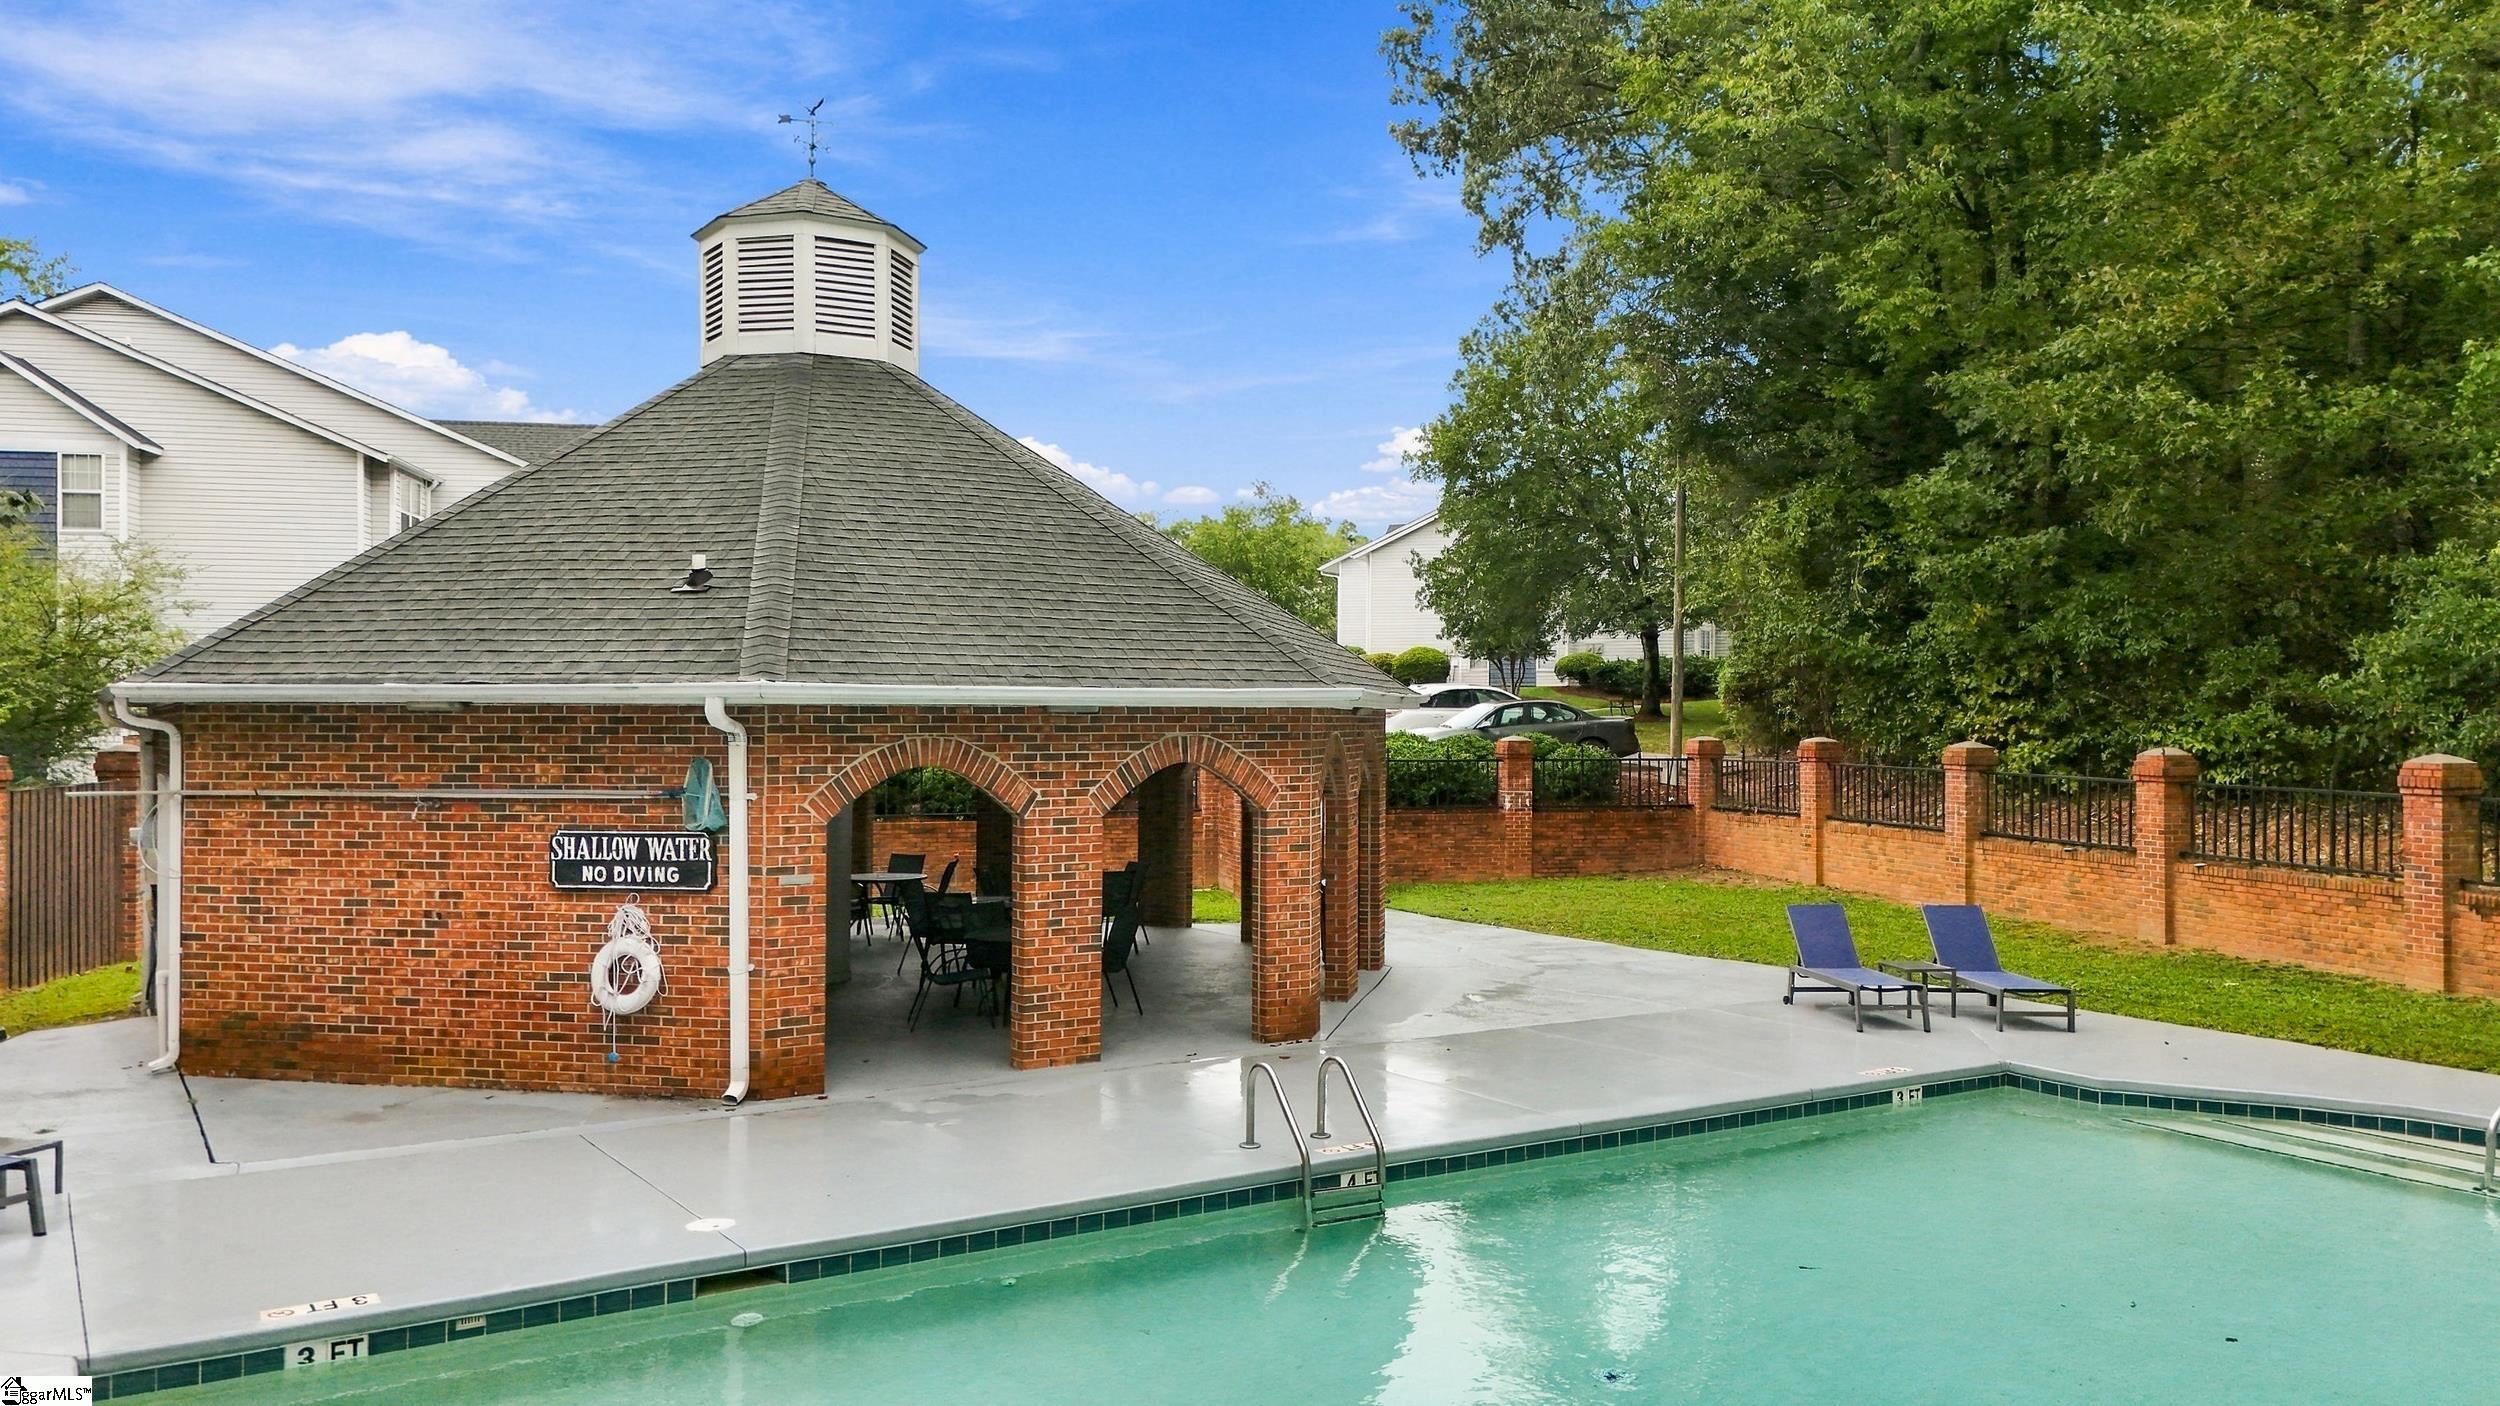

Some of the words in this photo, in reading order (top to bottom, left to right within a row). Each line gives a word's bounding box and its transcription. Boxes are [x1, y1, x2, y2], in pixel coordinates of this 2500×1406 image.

[551, 836, 640, 861] SHALLOW
[645, 837, 713, 861] WATER
[581, 865, 607, 882] NO
[613, 866, 680, 883] DIVING
[1896, 1090, 1904, 1101] 3
[1908, 1088, 1921, 1101] FT
[306, 1300, 338, 1313] FT
[351, 1295, 368, 1305] 3
[297, 1346, 316, 1365] 3
[331, 1337, 365, 1361] FT
